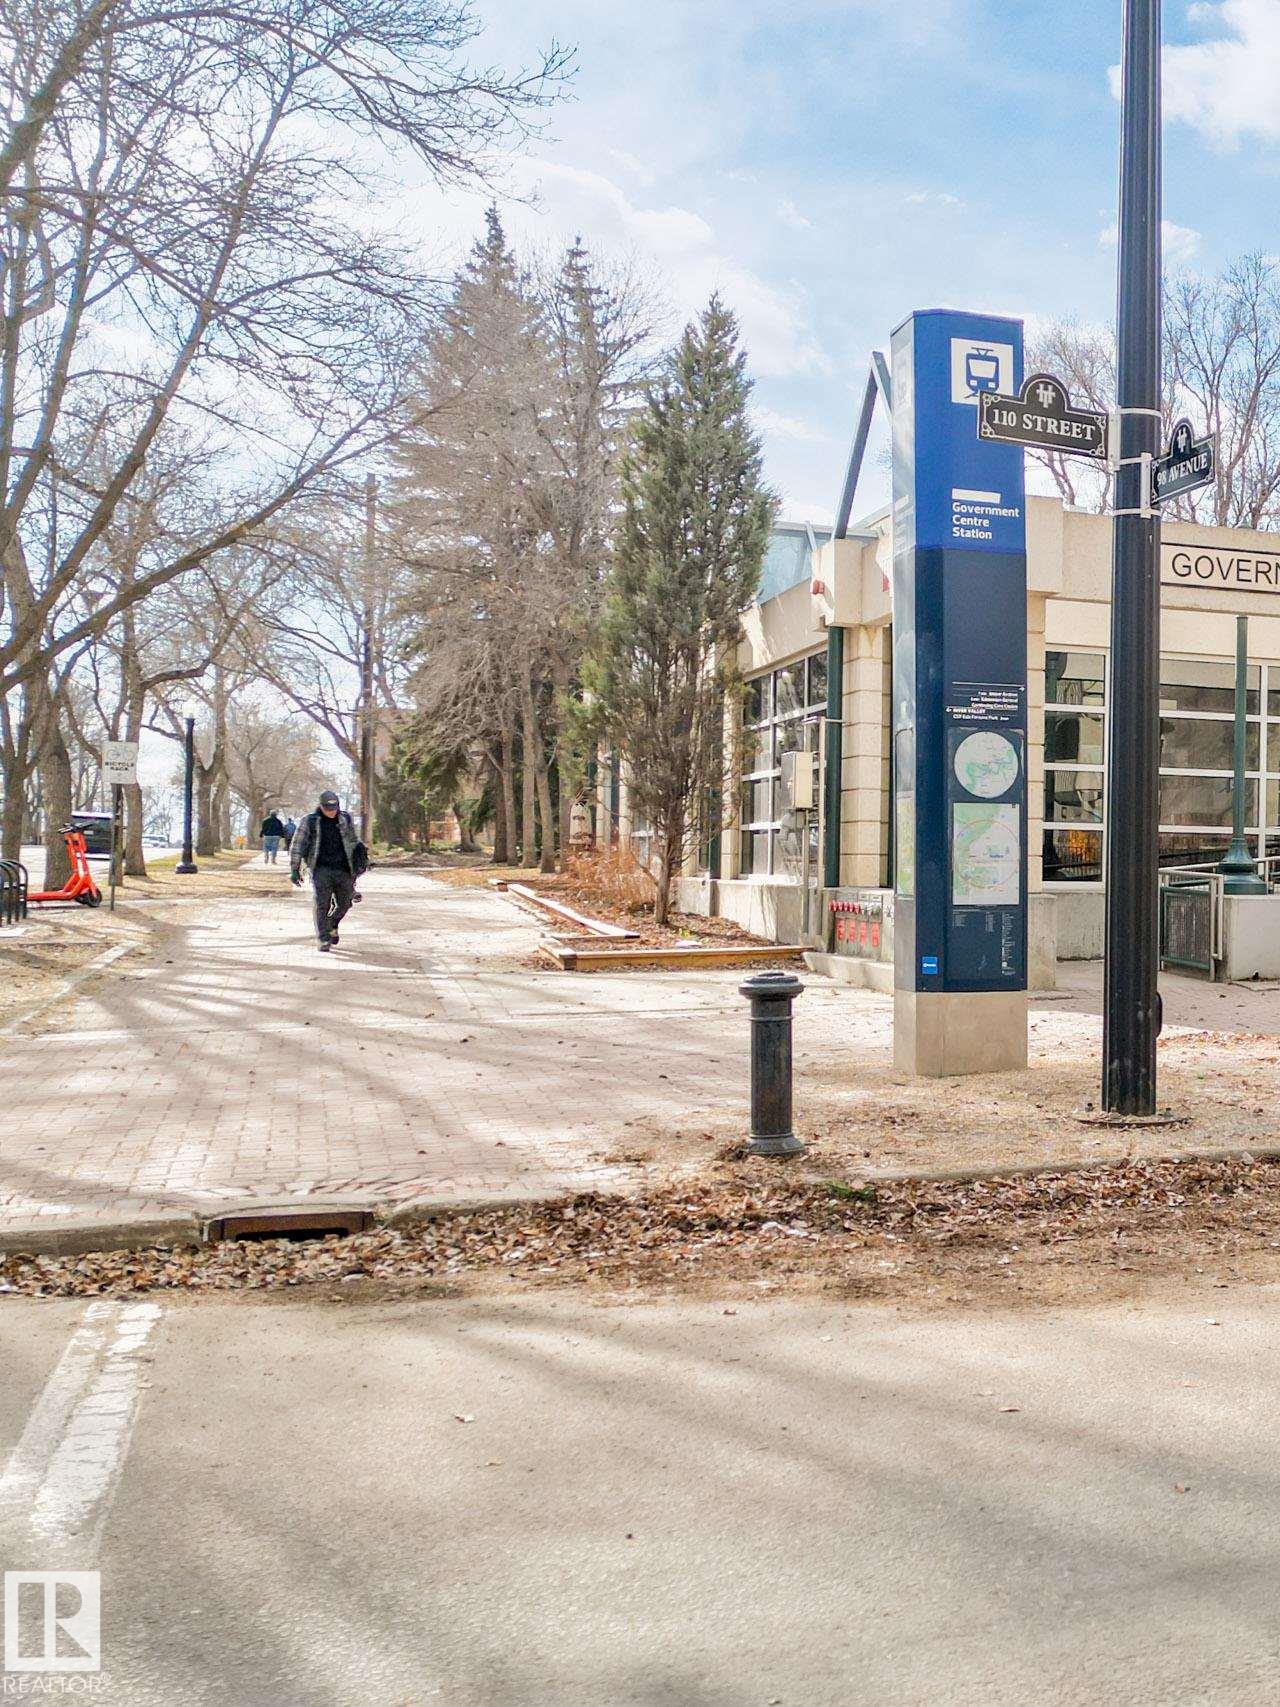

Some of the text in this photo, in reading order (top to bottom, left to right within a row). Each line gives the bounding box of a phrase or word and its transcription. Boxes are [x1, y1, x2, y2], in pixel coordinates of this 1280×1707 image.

[992, 408, 1096, 441] 110 STREET
[1156, 452, 1208, 487] 98 AVENUE
[952, 501, 1020, 518] Government
[952, 514, 990, 527] Centre
[952, 526, 993, 540] Station
